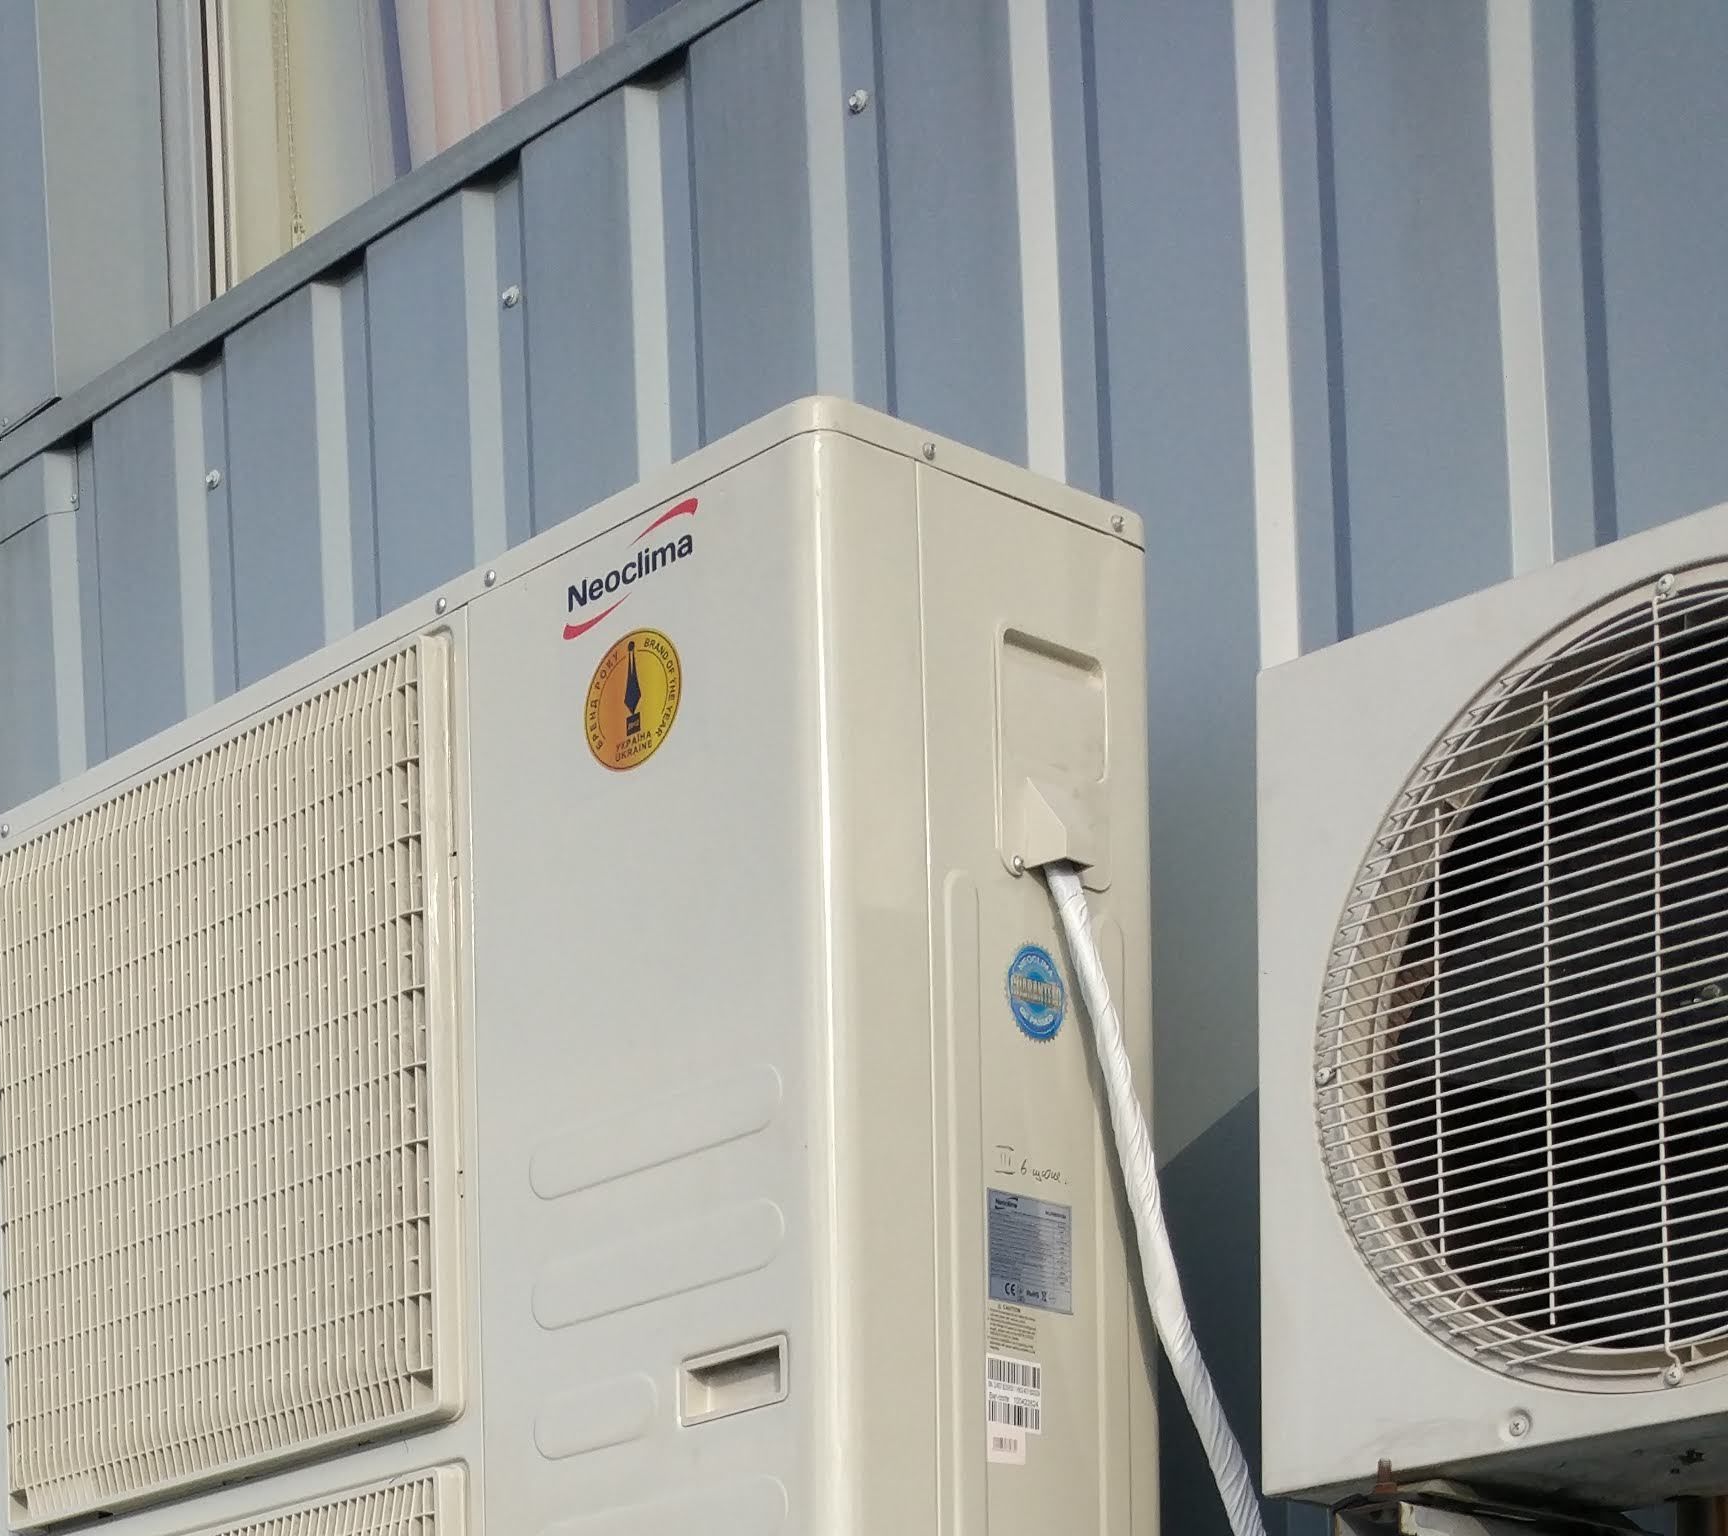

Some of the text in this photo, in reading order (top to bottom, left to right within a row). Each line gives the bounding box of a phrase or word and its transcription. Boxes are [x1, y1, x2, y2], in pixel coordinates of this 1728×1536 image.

[567, 534, 693, 613] Neoclima
[644, 638, 678, 738] BRAND OF THE YEAR
[615, 730, 652, 753] УКРАЇНА
[615, 740, 653, 762] UKRAINE
